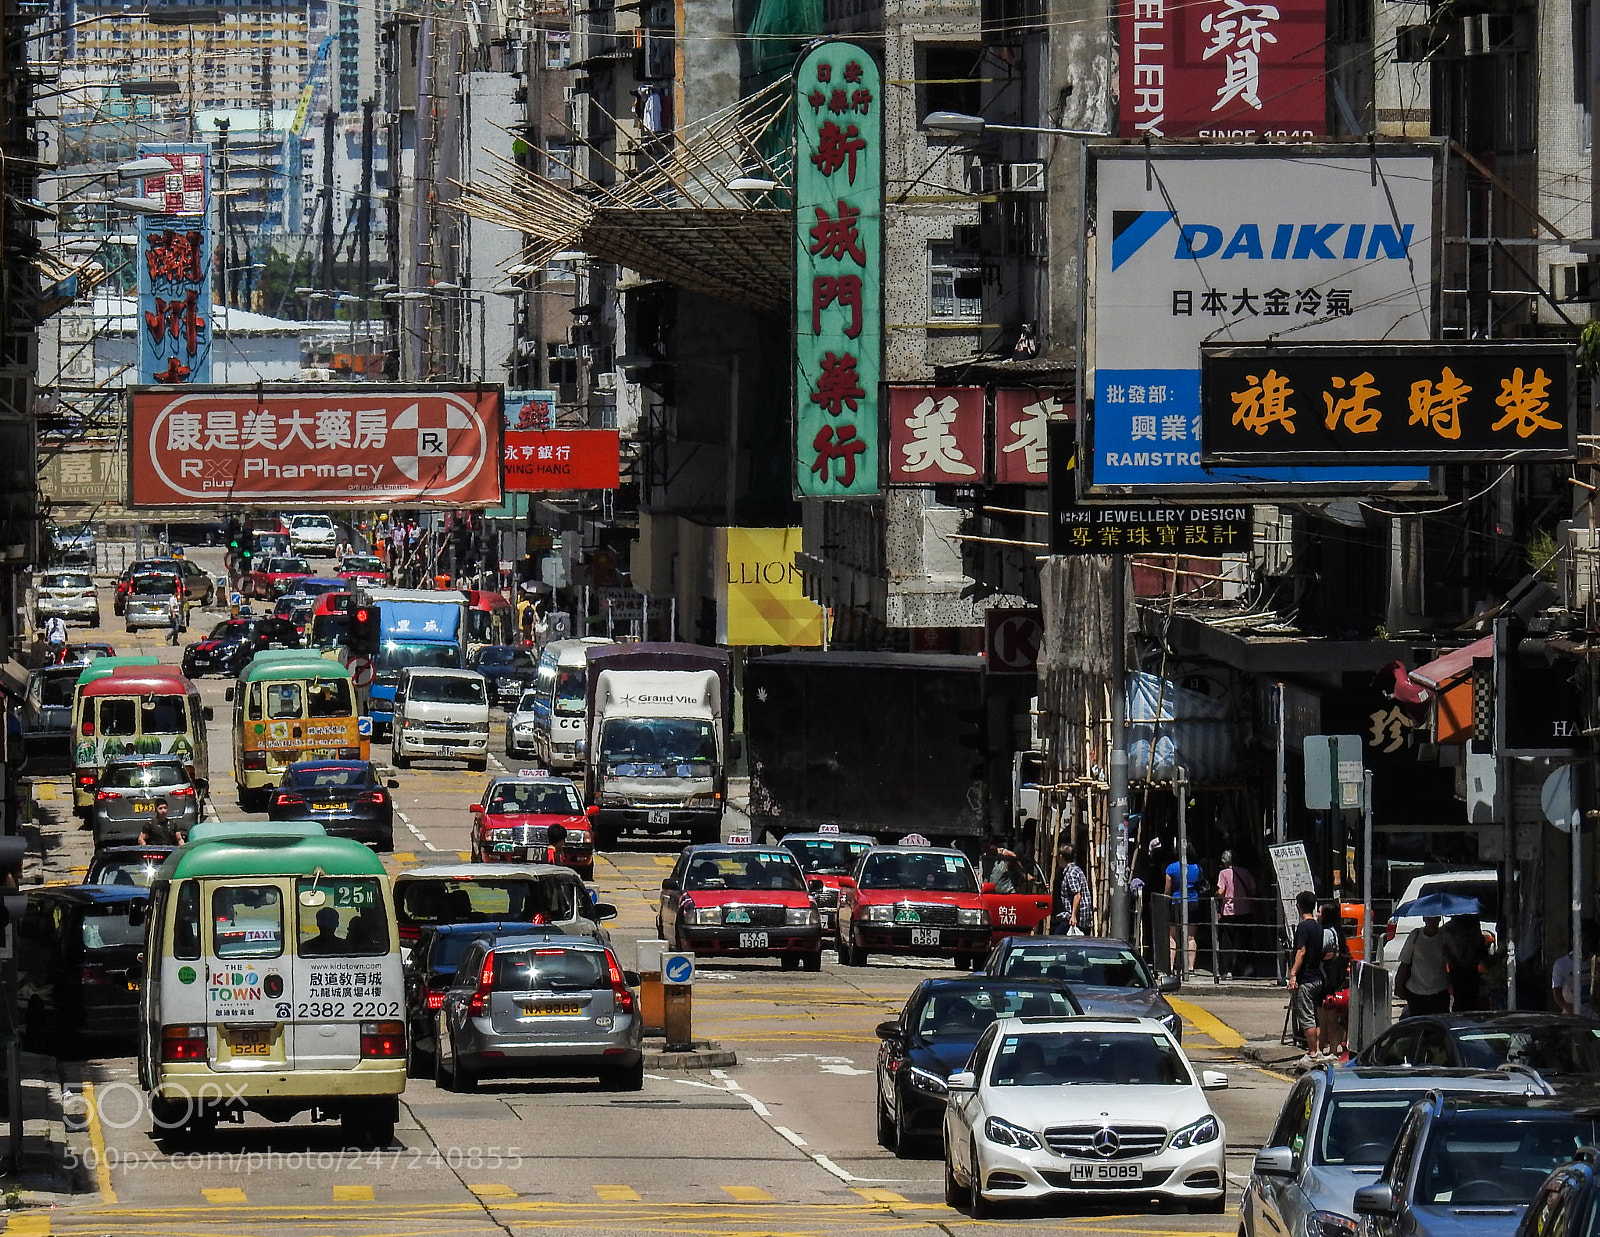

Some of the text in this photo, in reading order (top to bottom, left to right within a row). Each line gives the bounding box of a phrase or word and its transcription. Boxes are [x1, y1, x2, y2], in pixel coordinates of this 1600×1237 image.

[1174, 223, 1415, 261] DAIKIN
[809, 121, 868, 489] 新城門藥行
[1172, 287, 1354, 318] 日本大金冷氣
[1229, 365, 1564, 440] 旗活時裝
[166, 408, 388, 451] 康是美大藥房
[504, 445, 571, 461] 永亨銀行
[244, 457, 384, 485] Pharmacy
[537, 464, 570, 475] HANG
[202, 477, 234, 491] plus
[1096, 509, 1185, 523] JEWELLERY
[1190, 507, 1246, 521] DESIGN
[1068, 524, 1238, 546] 專業珠寶設計
[638, 694, 674, 702] Grand
[1369, 705, 1413, 753] 珍
[821, 825, 838, 833] TAXI
[730, 836, 749, 844] TAXI
[998, 906, 1017, 916] 的士
[1000, 916, 1017, 925] TAXI
[248, 931, 272, 939] TAXI
[209, 988, 261, 1001] TOWN
[298, 1002, 400, 1017] 2382 2202
[235, 1044, 266, 1054] 5212
[1074, 1165, 1138, 1178] HW 5089
